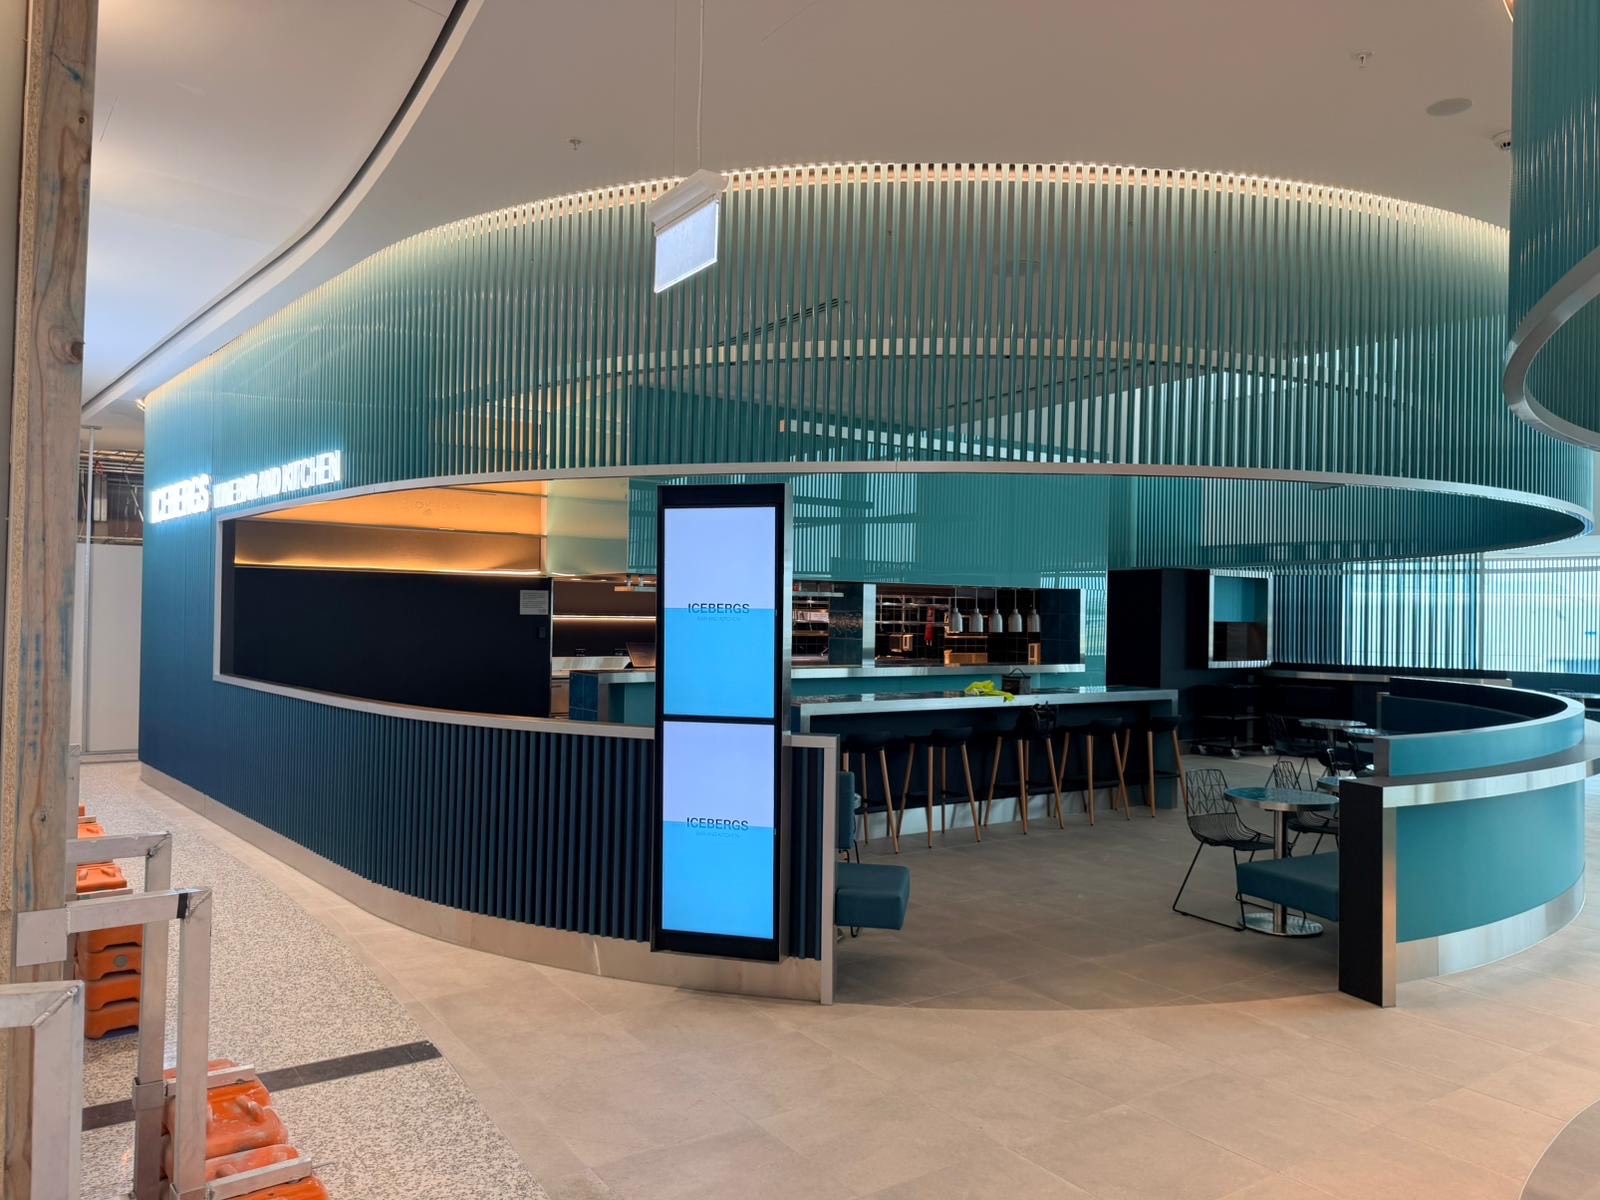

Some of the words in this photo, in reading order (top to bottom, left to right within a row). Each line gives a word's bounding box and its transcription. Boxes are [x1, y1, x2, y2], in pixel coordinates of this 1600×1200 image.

[281, 450, 341, 492] KITCHEN
[688, 602, 750, 614] ICEBERGS
[686, 817, 749, 831] ICEBERGS
